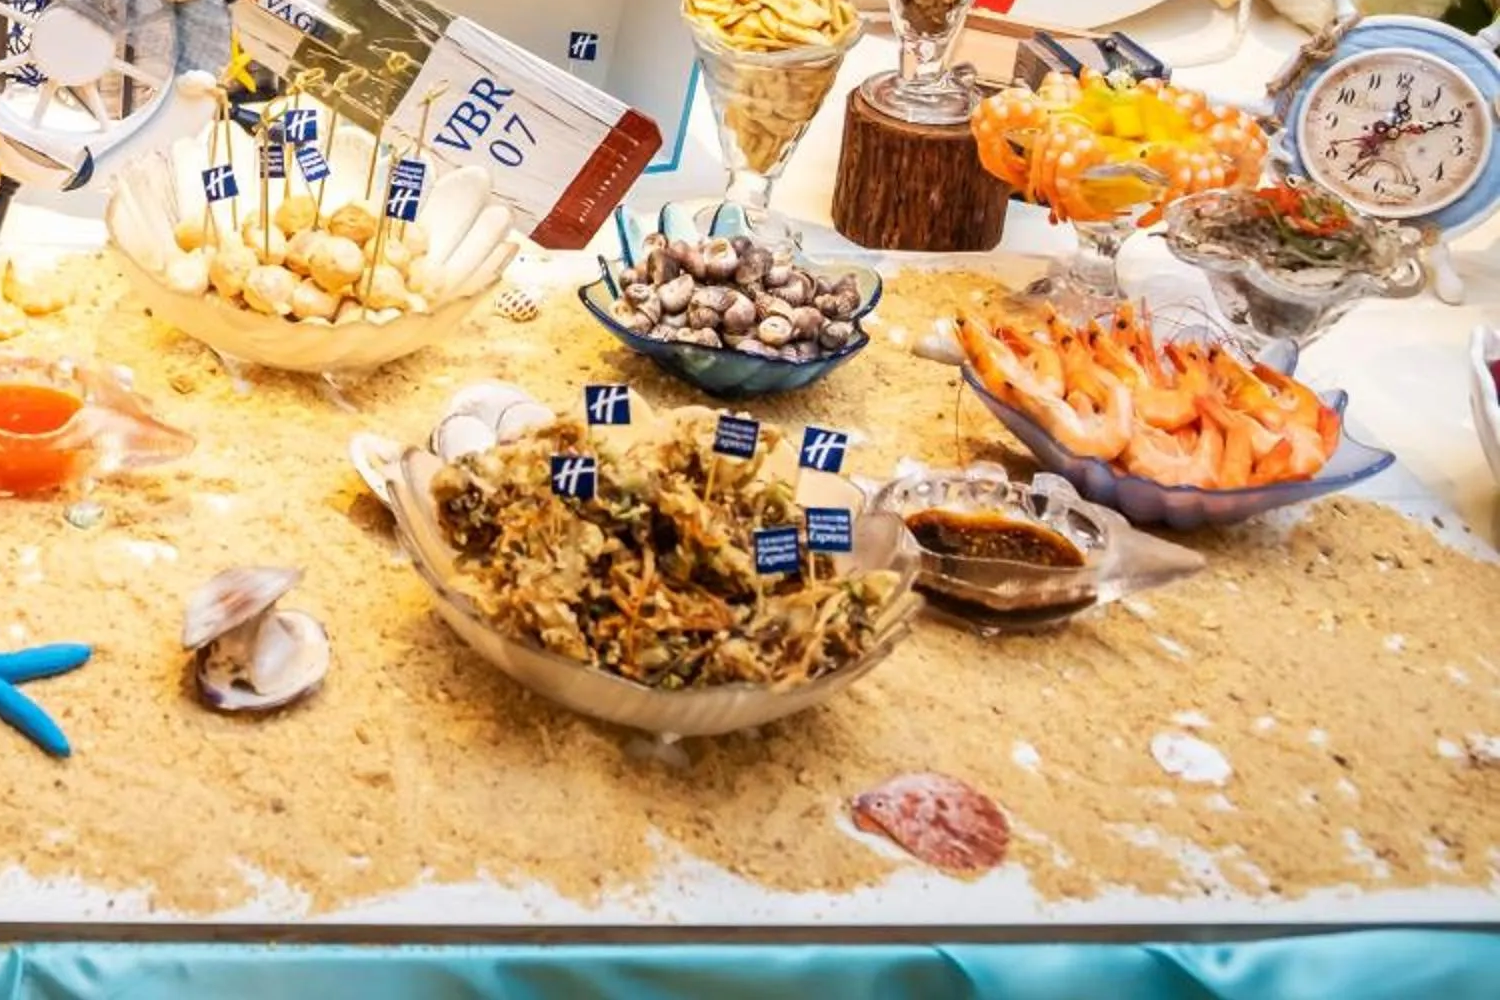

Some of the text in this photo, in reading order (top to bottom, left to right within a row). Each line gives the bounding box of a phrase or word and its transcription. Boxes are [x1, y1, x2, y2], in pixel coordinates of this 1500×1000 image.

[1336, 87, 1355, 104] 10
[1368, 72, 1381, 90] 11
[433, 77, 514, 155] VBR
[489, 114, 537, 167] 07
